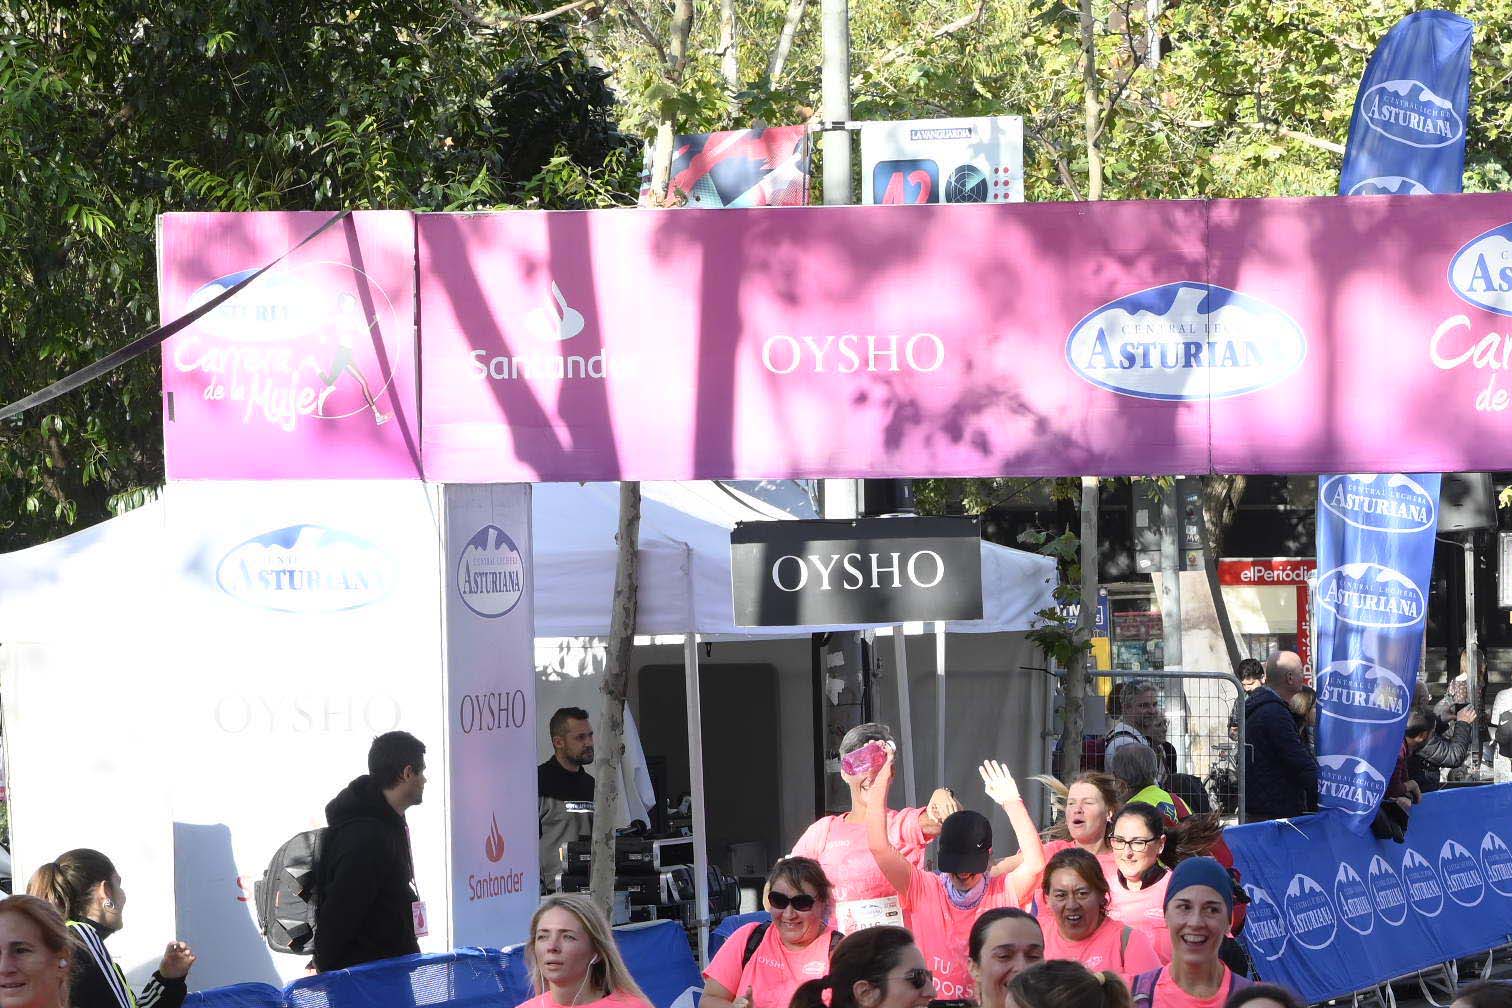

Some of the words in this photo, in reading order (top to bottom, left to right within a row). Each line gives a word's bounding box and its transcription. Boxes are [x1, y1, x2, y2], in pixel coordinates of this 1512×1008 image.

[1368, 94, 1454, 138] ASTURIANA
[761, 332, 945, 374] OYSHO
[1475, 372, 1511, 412] de
[1331, 484, 1429, 524] ASTURIANA
[462, 559, 521, 594] ASTURIANA
[772, 551, 945, 592] OYSHO
[1324, 578, 1420, 618] ASTURIANA
[460, 690, 526, 734] OYSHO
[469, 868, 524, 901] Santander
[933, 956, 951, 975] TU
[932, 977, 974, 999] DORS
